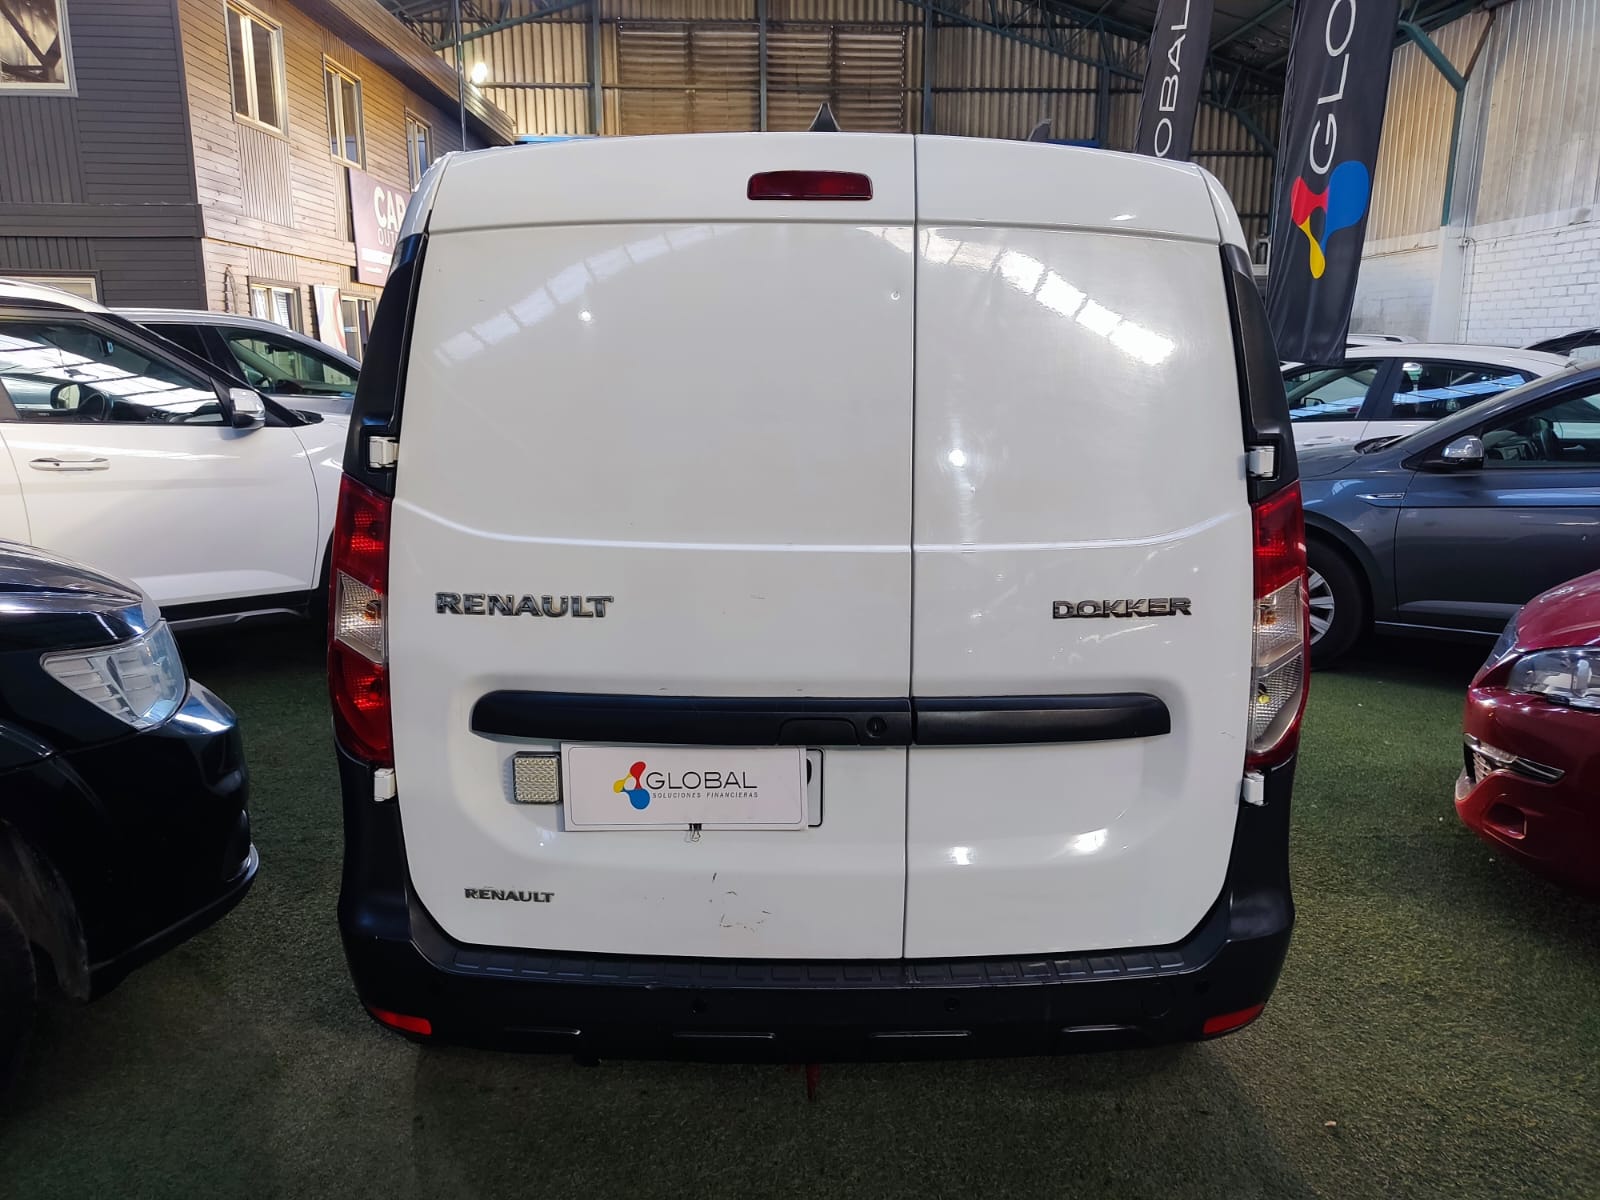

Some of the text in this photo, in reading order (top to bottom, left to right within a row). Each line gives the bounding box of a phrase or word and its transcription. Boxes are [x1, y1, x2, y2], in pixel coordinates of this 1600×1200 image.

[435, 592, 615, 618] RENAULT
[1052, 597, 1193, 619] DOKKER
[646, 771, 758, 790] GLOBAL
[652, 791, 759, 799] SOLUCIONES FINANCIERAS
[463, 887, 555, 903] RENAULT
